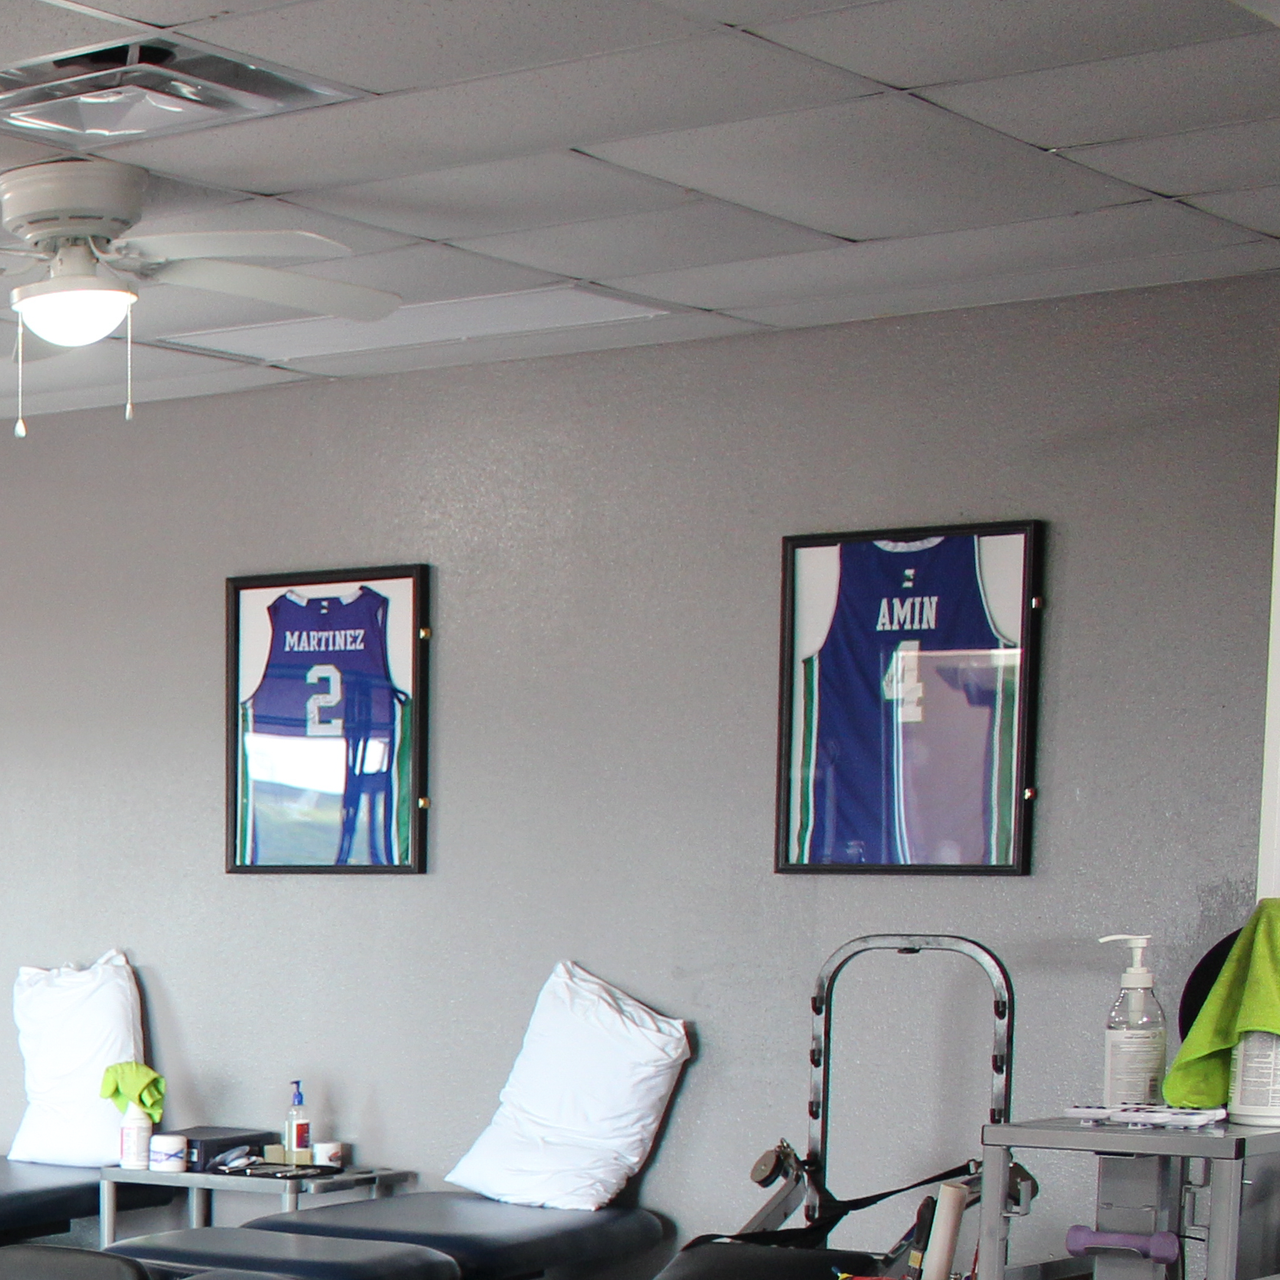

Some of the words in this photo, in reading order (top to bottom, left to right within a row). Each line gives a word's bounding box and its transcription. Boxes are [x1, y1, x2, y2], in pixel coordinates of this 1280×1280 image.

[876, 596, 938, 631] AMIN
[284, 629, 365, 652] MARTINEZ
[305, 664, 344, 737] 2
